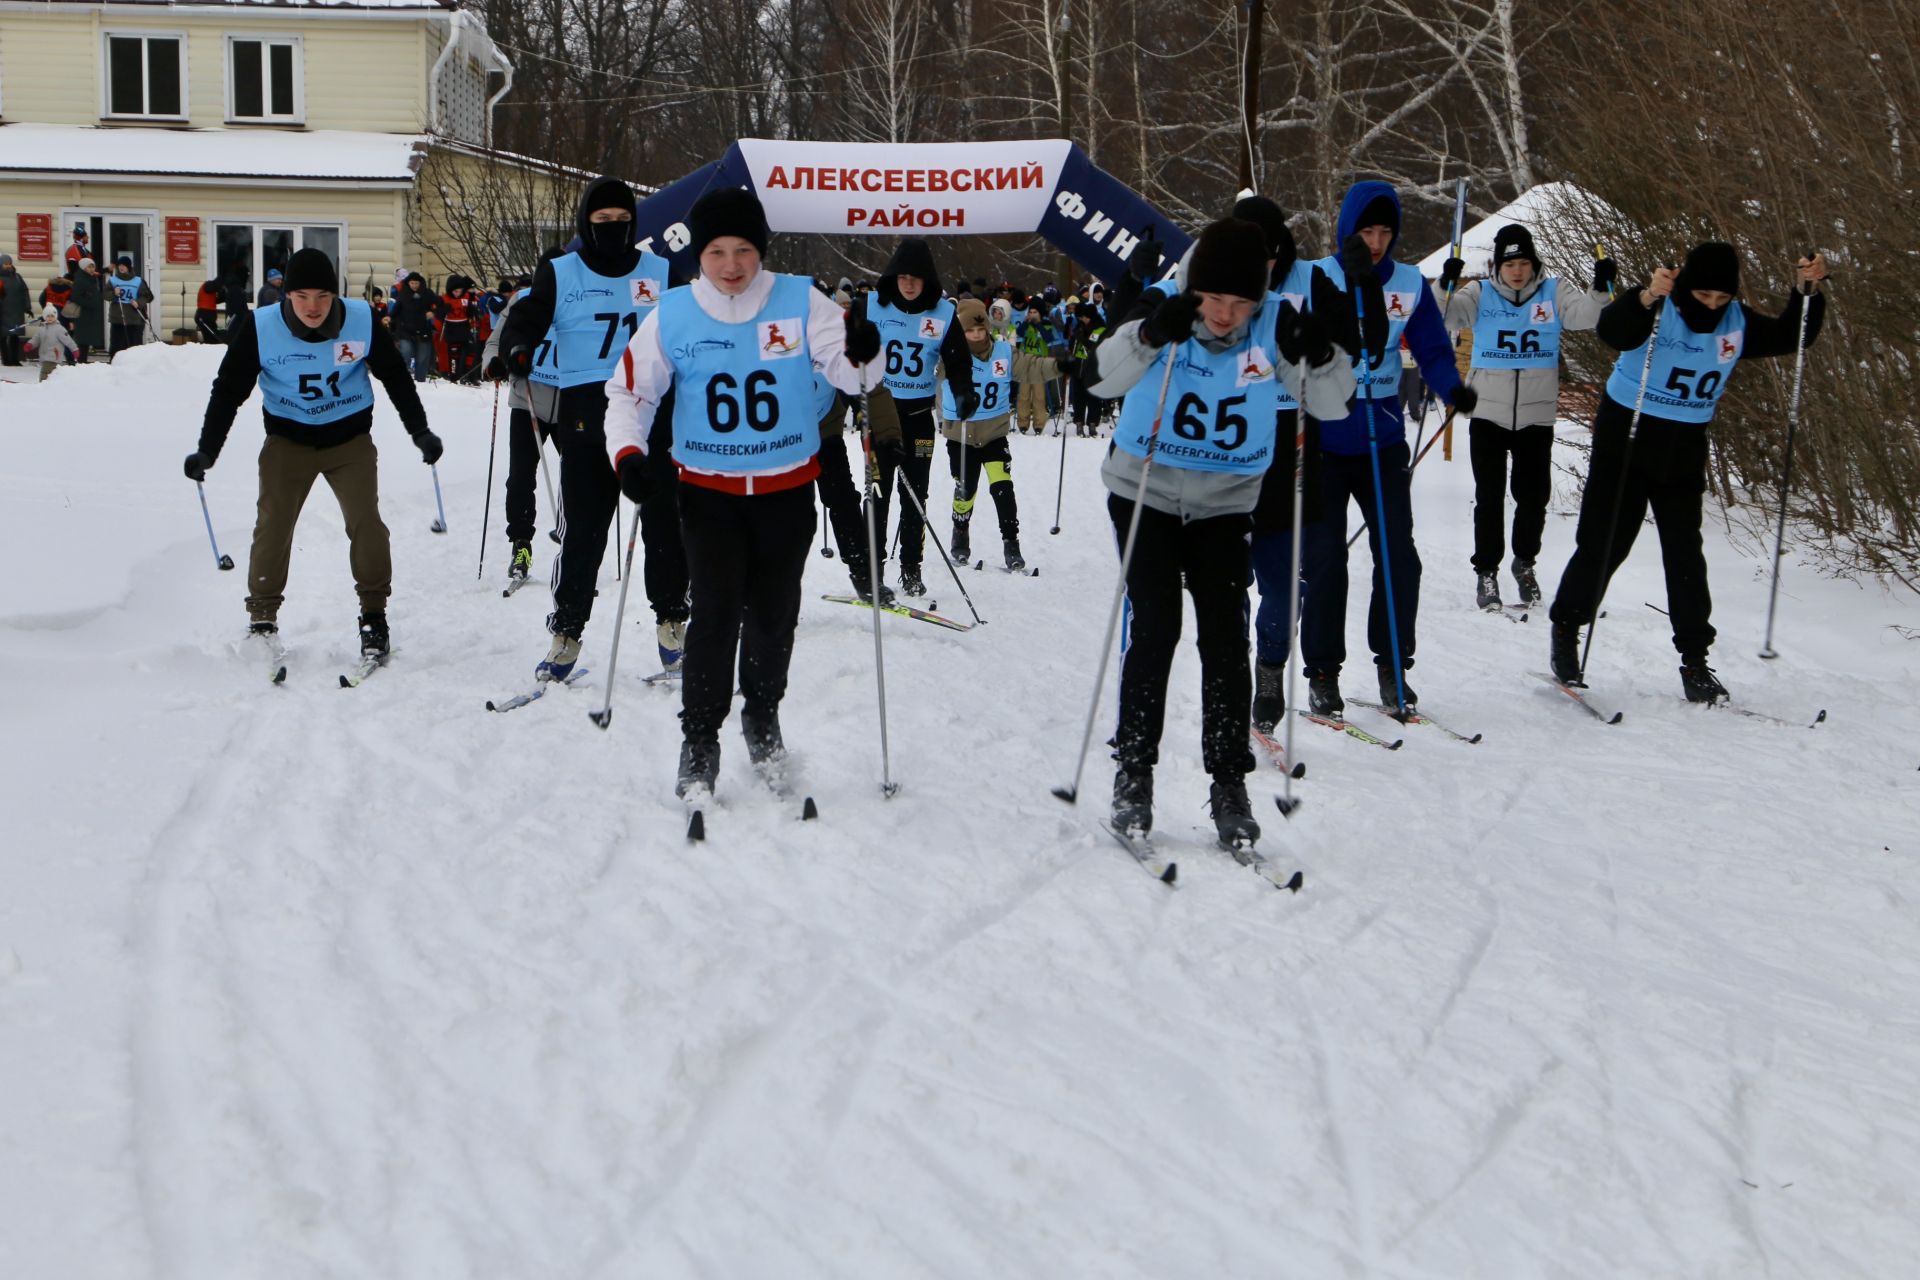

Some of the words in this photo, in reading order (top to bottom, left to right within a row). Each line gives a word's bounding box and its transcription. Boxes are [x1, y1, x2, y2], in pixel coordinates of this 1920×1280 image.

[766, 161, 1043, 192] АЛЕКСЕЕВСКИЙ
[847, 204, 965, 228] РАЙОН
[594, 312, 638, 359] 71
[1497, 329, 1540, 354] 56
[885, 339, 924, 378] 63
[298, 371, 341, 401] 51
[705, 369, 780, 433] 66
[1643, 391, 1706, 408] ЛЕКСЕЕВСКИЙ
[1173, 391, 1248, 451] 65
[684, 440, 767, 456] АЛЕКСЕЕВСКИЙ
[769, 433, 803, 451] РАЙОН
